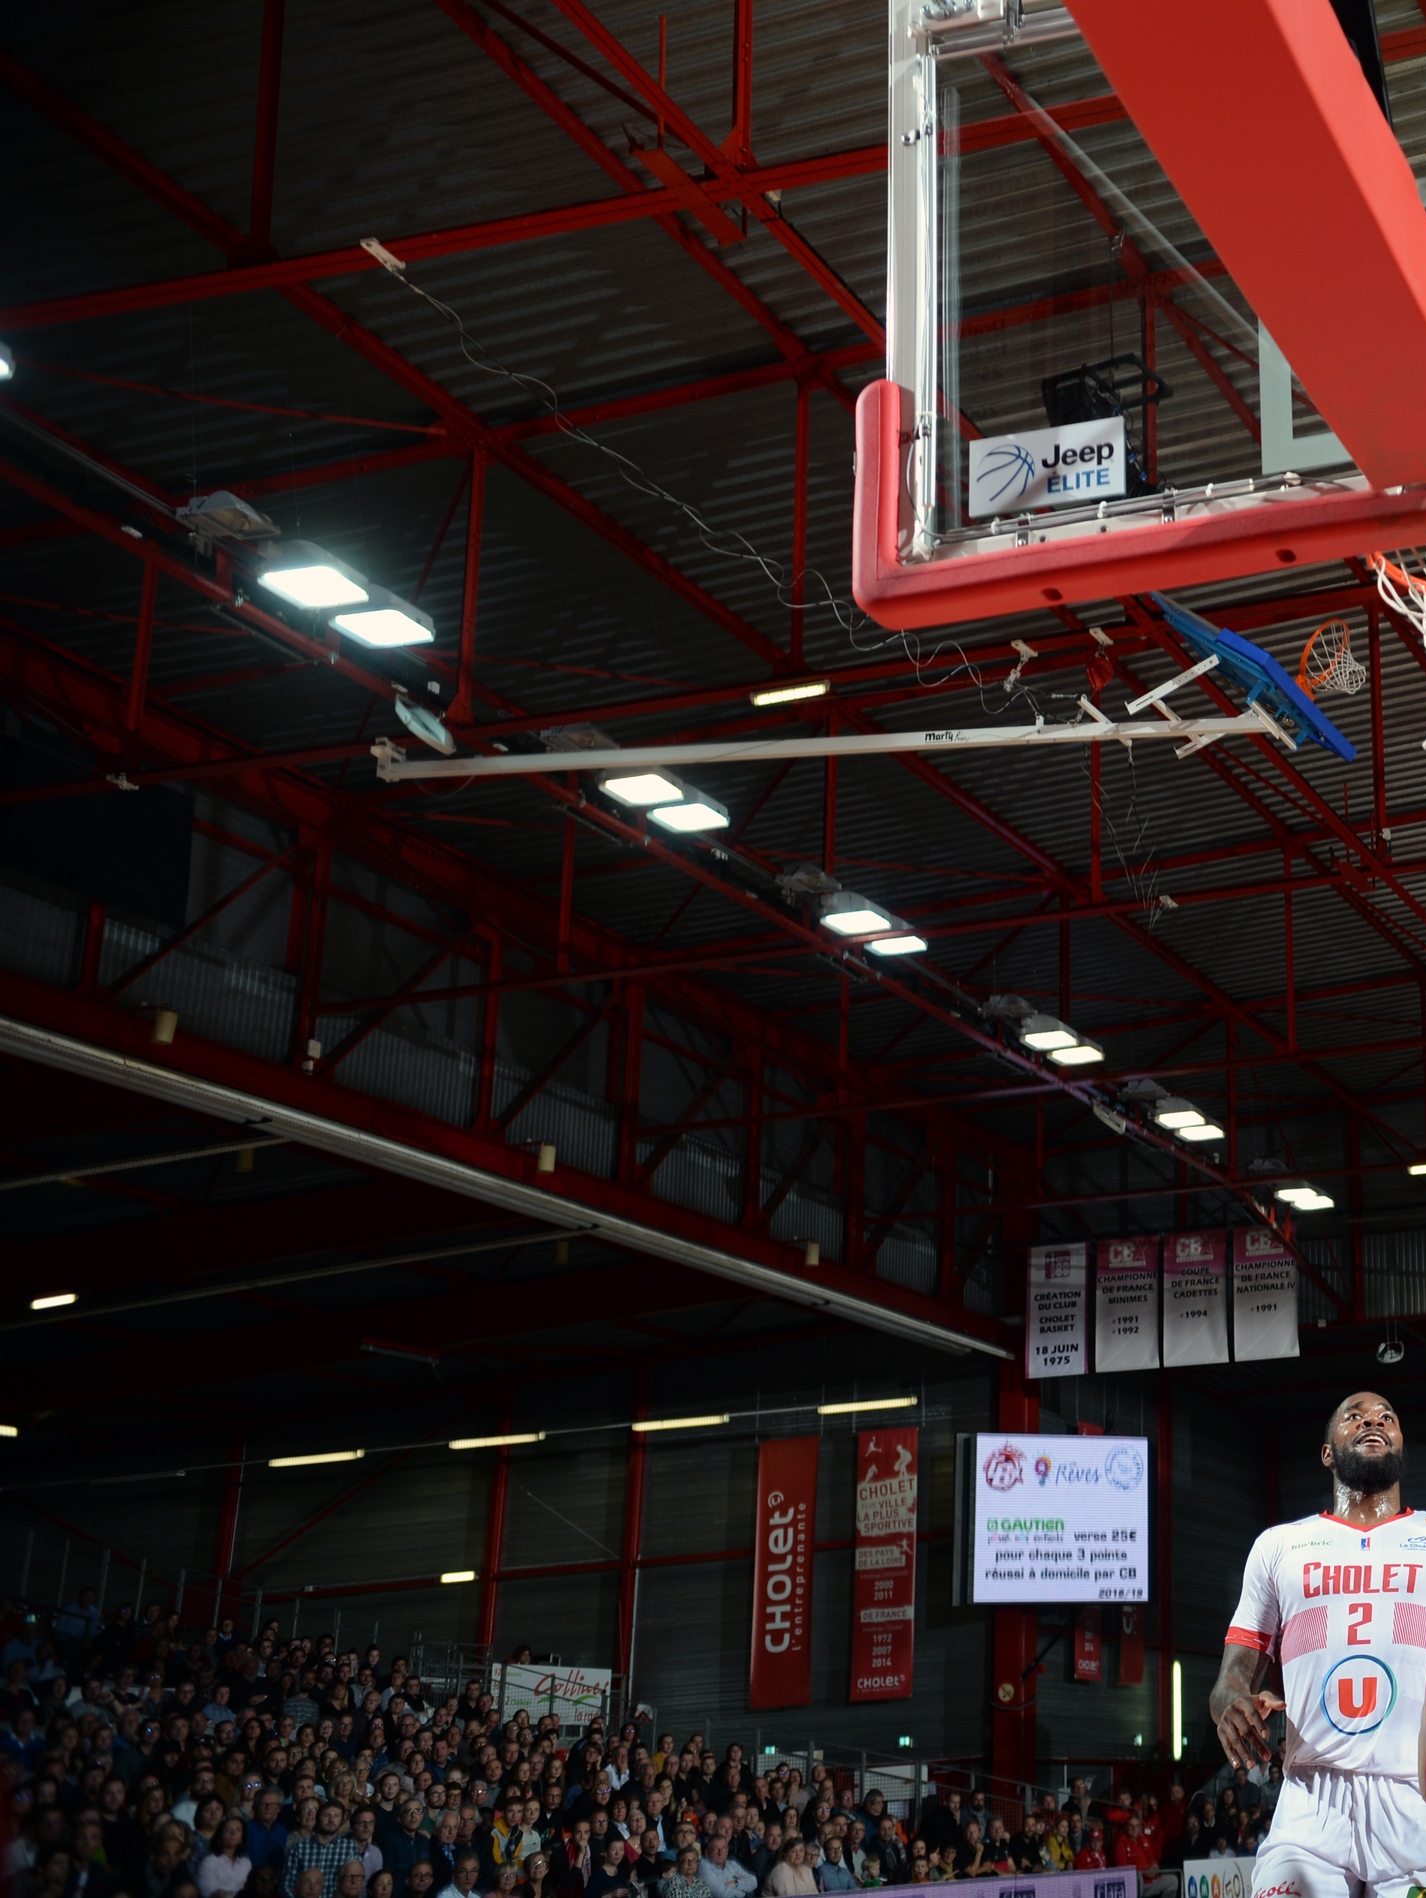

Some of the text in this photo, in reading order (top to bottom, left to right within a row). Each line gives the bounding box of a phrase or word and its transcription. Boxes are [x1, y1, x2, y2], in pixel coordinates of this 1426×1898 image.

[1041, 442, 1114, 468] Jeep
[1047, 468, 1110, 494] ÉLITE
[1235, 1259, 1296, 1272] CHAMPIONNE
[1180, 1267, 1210, 1276] COUPE
[1241, 1271, 1291, 1283] DE FRANCE
[1097, 1272, 1157, 1284] CHAMPIONNE
[1171, 1277, 1219, 1288] DE FRANCE
[1102, 1283, 1153, 1294] DE FRANCE
[1236, 1281, 1296, 1294] NATIONALE IV
[1034, 1291, 1081, 1302] CRÉATION
[1173, 1288, 1218, 1299] CADETTES
[1108, 1295, 1148, 1305] MINIMES
[1038, 1301, 1077, 1311] DU CLUB
[1256, 1304, 1277, 1313] 1991
[1039, 1314, 1076, 1324] CHOLET
[1185, 1310, 1208, 1318] 1994
[1117, 1316, 1139, 1324] 1991
[1039, 1324, 1075, 1334] BASKET
[1117, 1327, 1139, 1335] 1992
[1035, 1343, 1079, 1355] 18 JUIN
[1043, 1356, 1071, 1366] 1975
[859, 1479, 915, 1501] CHOLET
[878, 1498, 907, 1509] VILLE
[857, 1509, 899, 1522] LA PLUS
[863, 1518, 913, 1533] SPORTIVE
[1074, 1531, 1107, 1542] verse
[859, 1547, 894, 1558] DES PAYS
[995, 1548, 1127, 1563] pour chaque 3 points
[858, 1556, 903, 1567] DE LA LOIRE
[985, 1567, 1137, 1582] réussi à domicile par CB
[1303, 1562, 1423, 1599] CHOLET
[873, 1590, 893, 1600] 2011
[862, 1609, 907, 1620] DE FRANCE
[1347, 1602, 1373, 1645] 2
[873, 1634, 892, 1643] 1972
[872, 1646, 892, 1656] 2007
[872, 1658, 892, 1668] 2014
[1338, 1677, 1378, 1718] U
